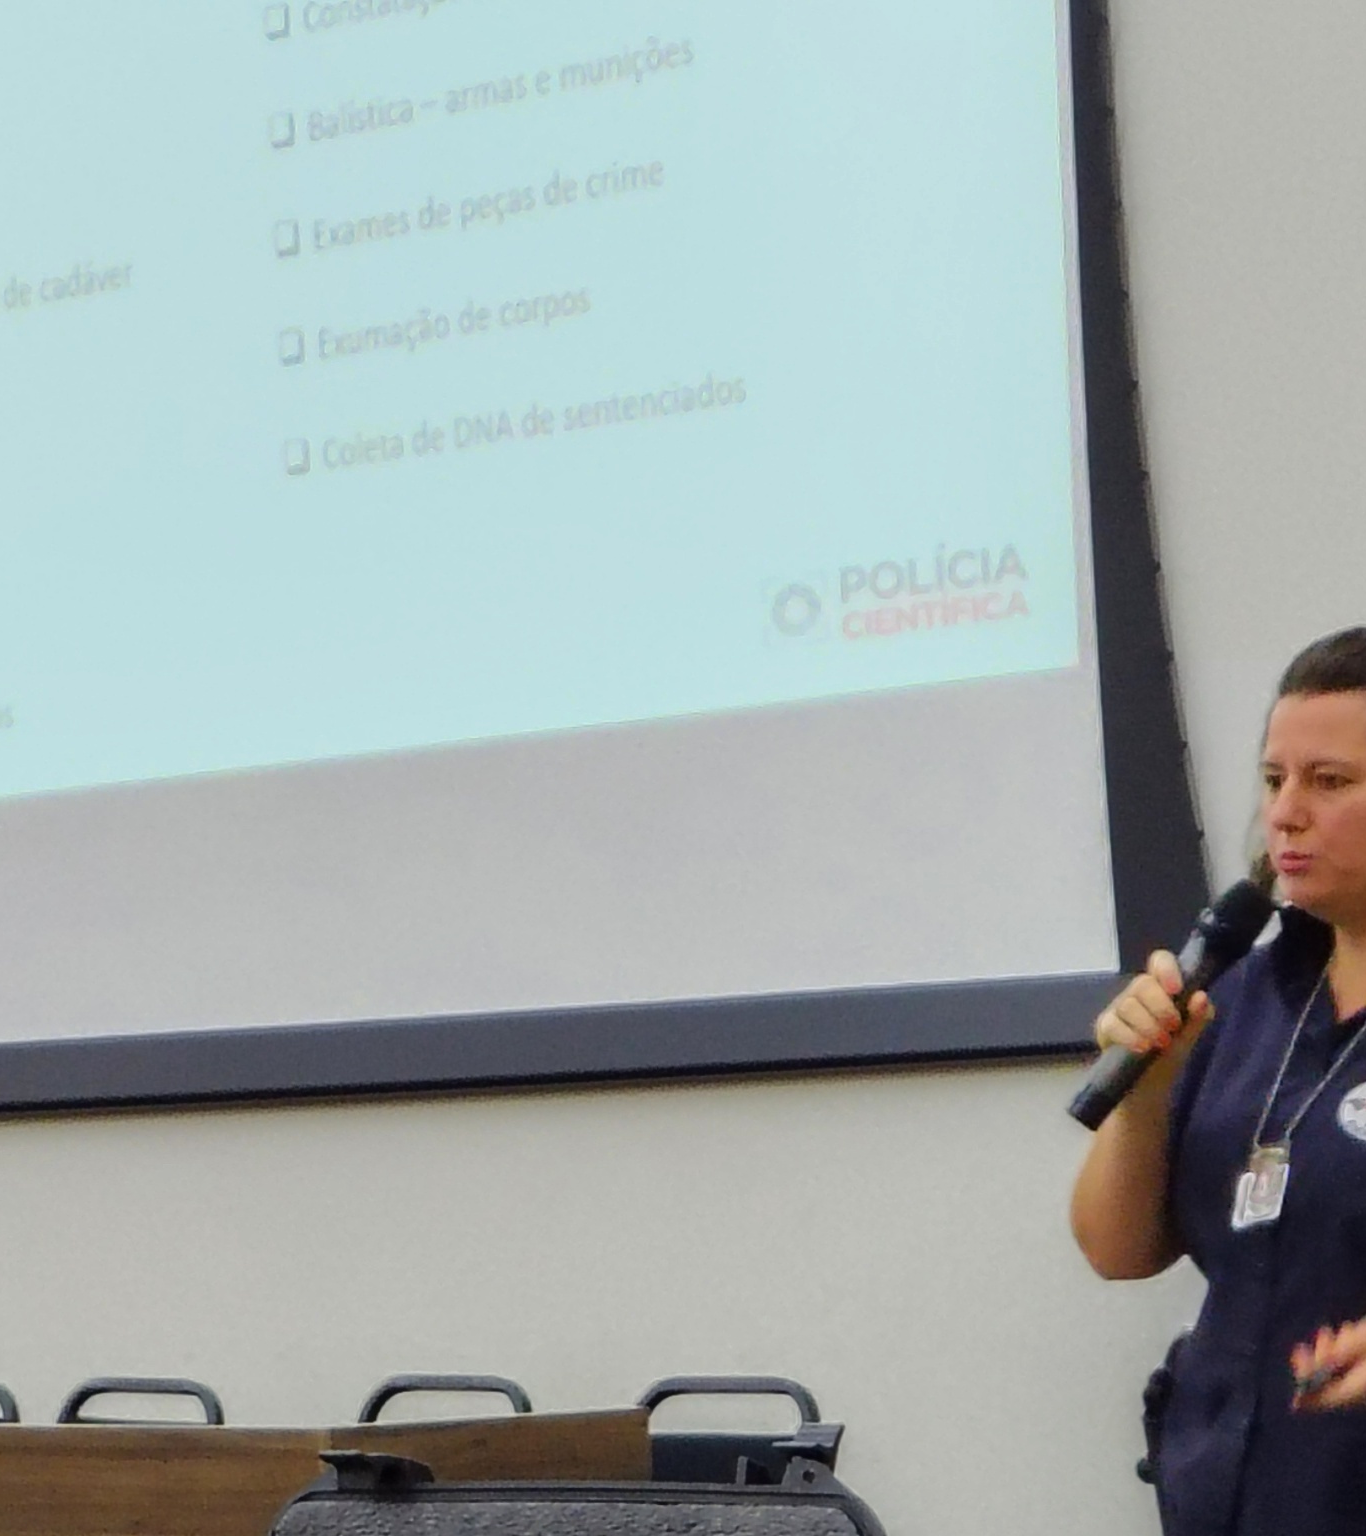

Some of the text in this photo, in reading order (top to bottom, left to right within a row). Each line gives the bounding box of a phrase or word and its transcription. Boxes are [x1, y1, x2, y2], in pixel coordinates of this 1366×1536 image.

[445, 74, 527, 114] armas
[536, 70, 550, 95] e
[559, 35, 695, 85] munições
[313, 160, 665, 250] Exames de peças de crime
[4, 273, 32, 310] de
[39, 260, 133, 303] cadáver
[458, 302, 491, 334] de
[498, 288, 591, 326] corpos
[323, 372, 747, 469] Coleta de DNA de sentenciados
[839, 542, 1028, 603] POLÍCIA
